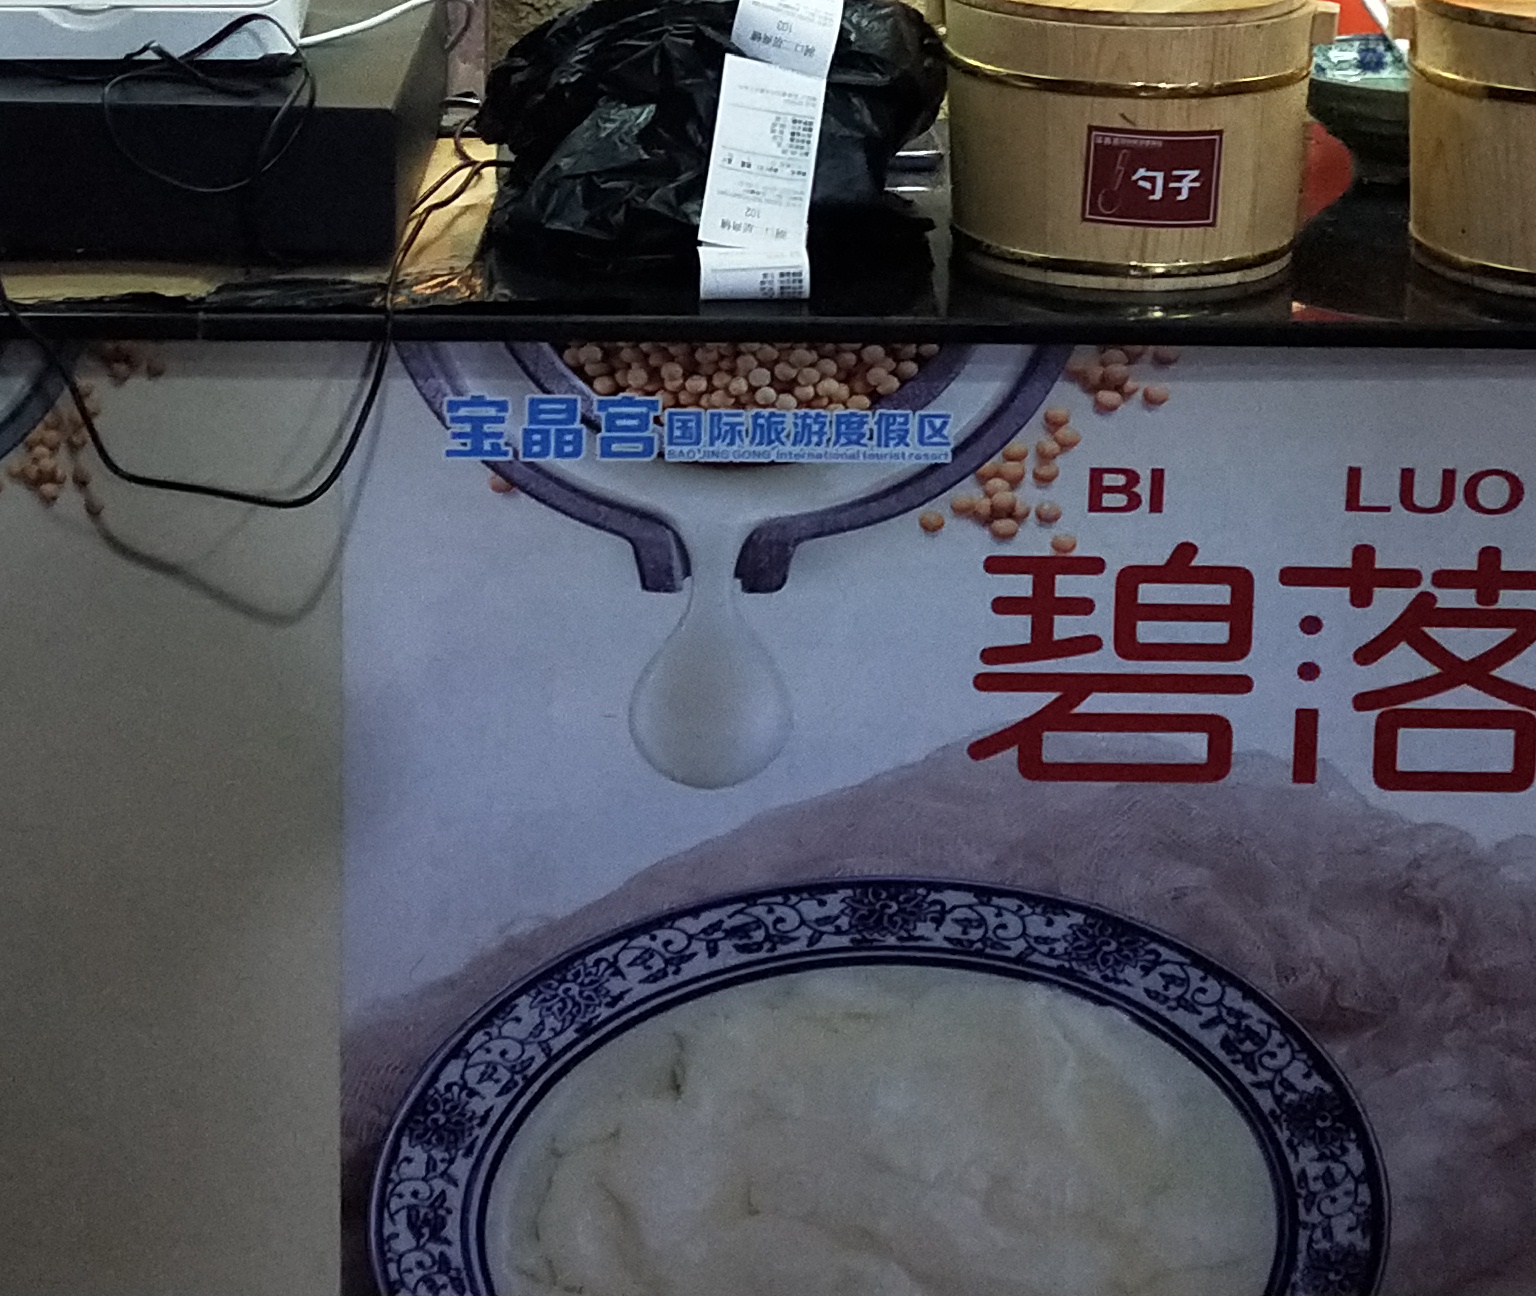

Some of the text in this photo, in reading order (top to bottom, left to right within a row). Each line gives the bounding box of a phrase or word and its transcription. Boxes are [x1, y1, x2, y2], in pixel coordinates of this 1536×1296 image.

[1131, 167, 1201, 201] 勺子
[445, 395, 952, 459] 宝晶宫 国际旅游度假区
[1087, 467, 1166, 515] BI
[1344, 466, 1526, 515] LUO
